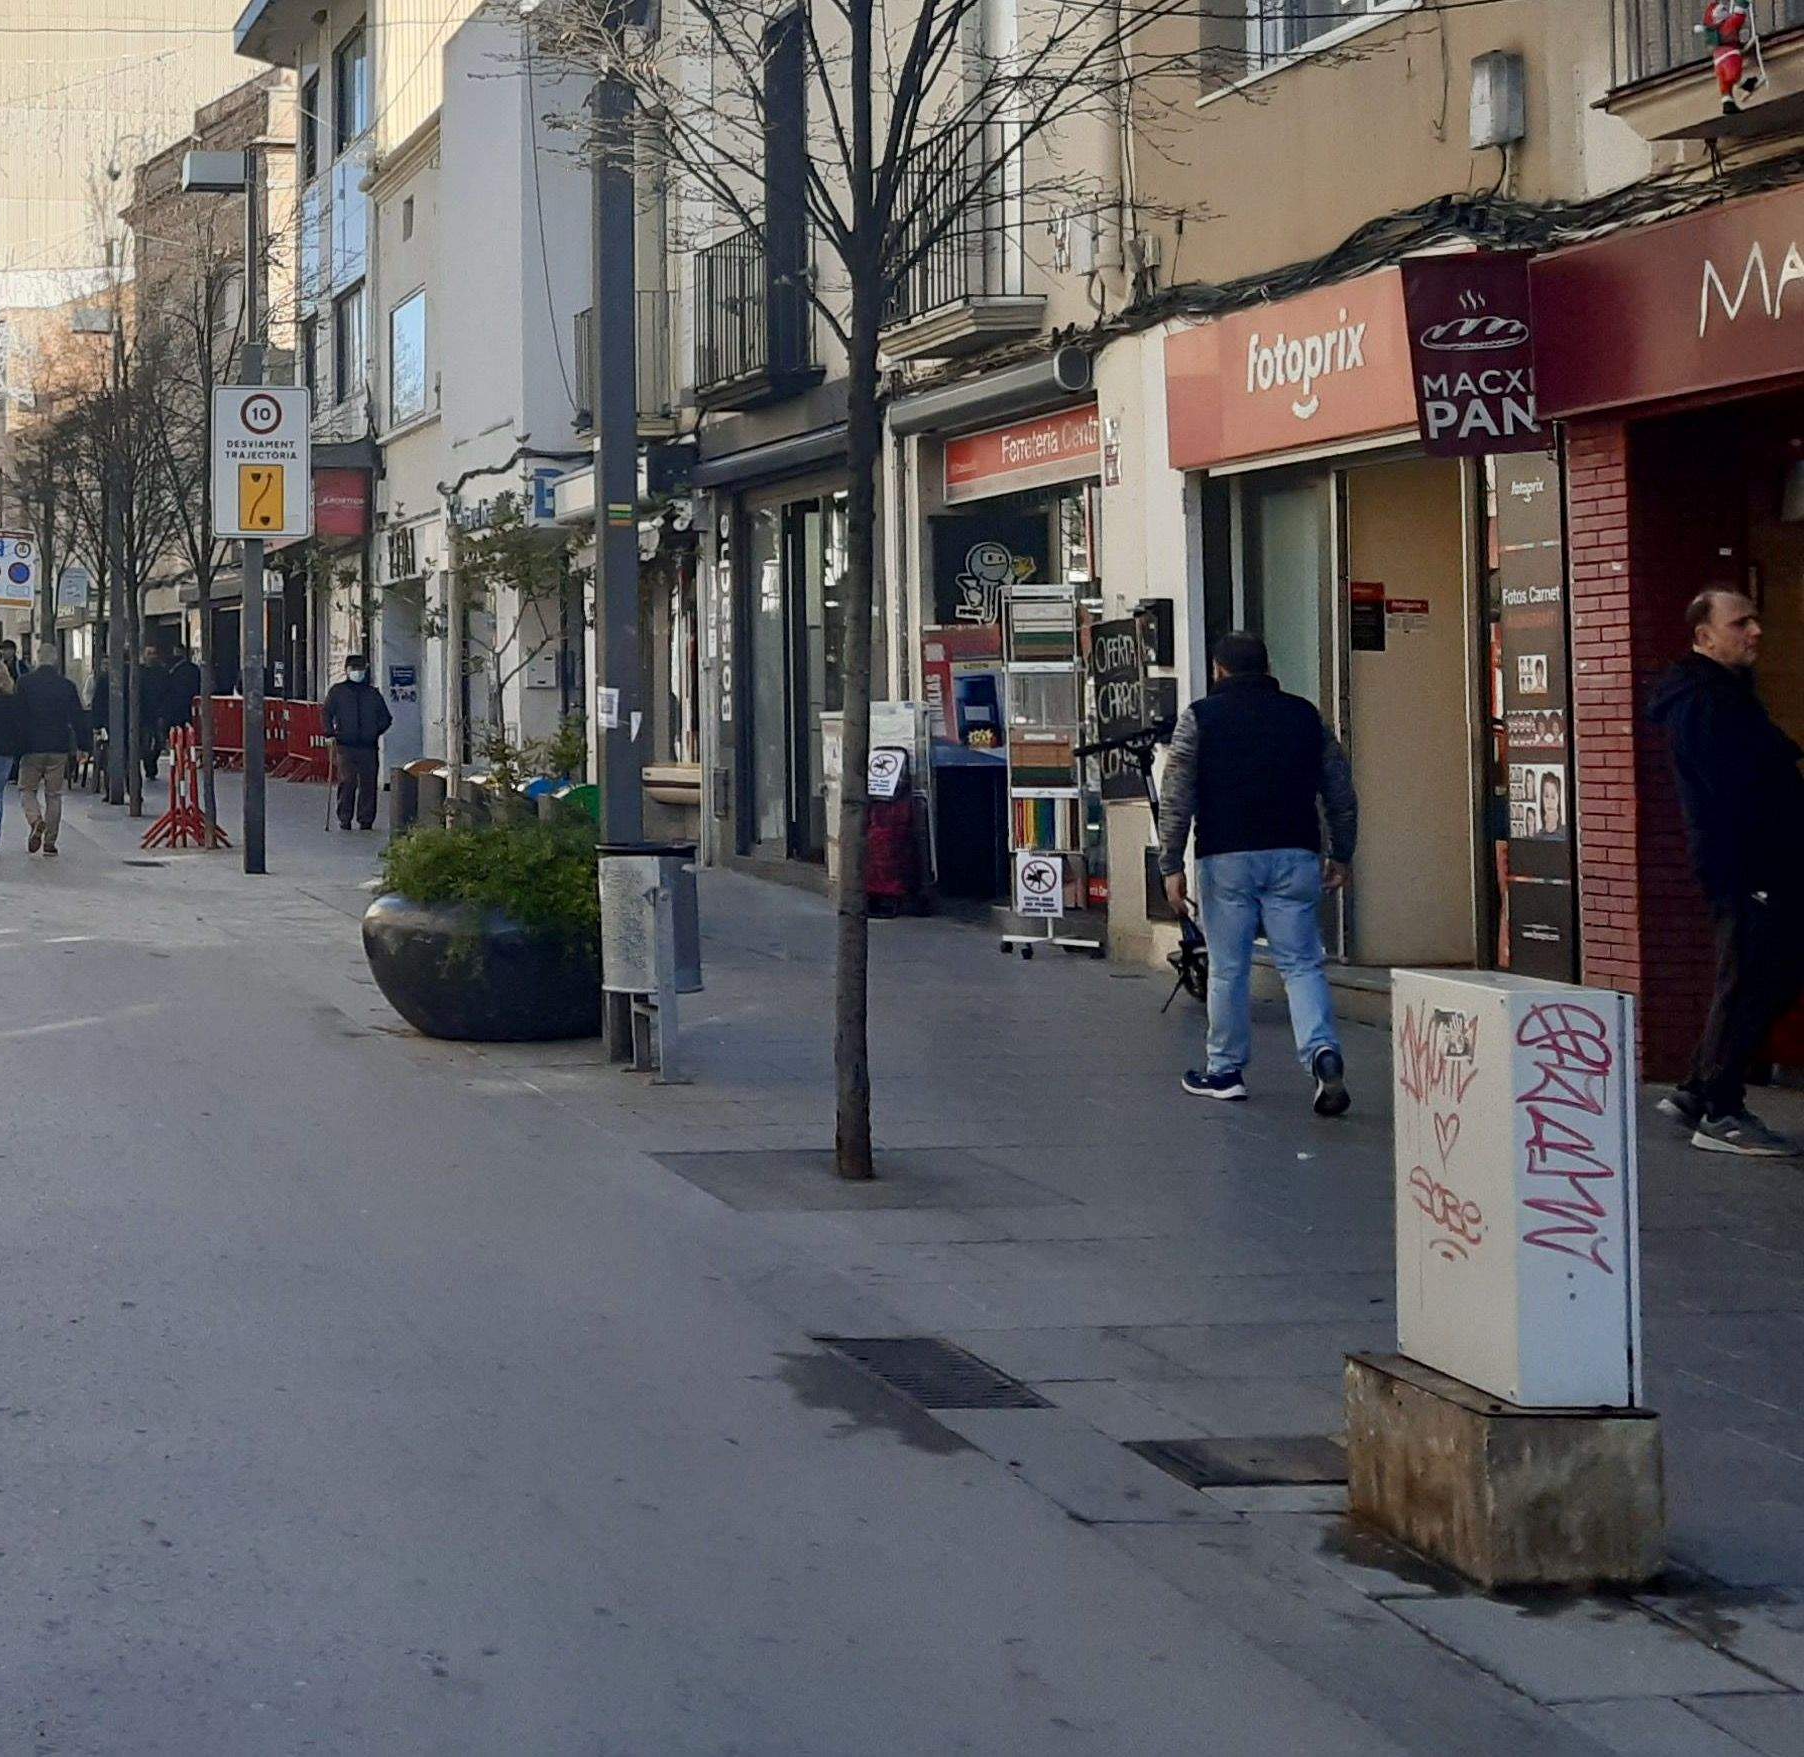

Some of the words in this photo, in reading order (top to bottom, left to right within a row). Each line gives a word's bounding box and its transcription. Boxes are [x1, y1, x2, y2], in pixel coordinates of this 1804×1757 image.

[1246, 307, 1366, 395] fotoprix
[251, 407, 271, 422] 10
[1425, 396, 1541, 440] PAN
[226, 440, 295, 449] DESVIAMENT
[1502, 589, 1527, 606] Fotos
[1528, 585, 1561, 602] Carnet
